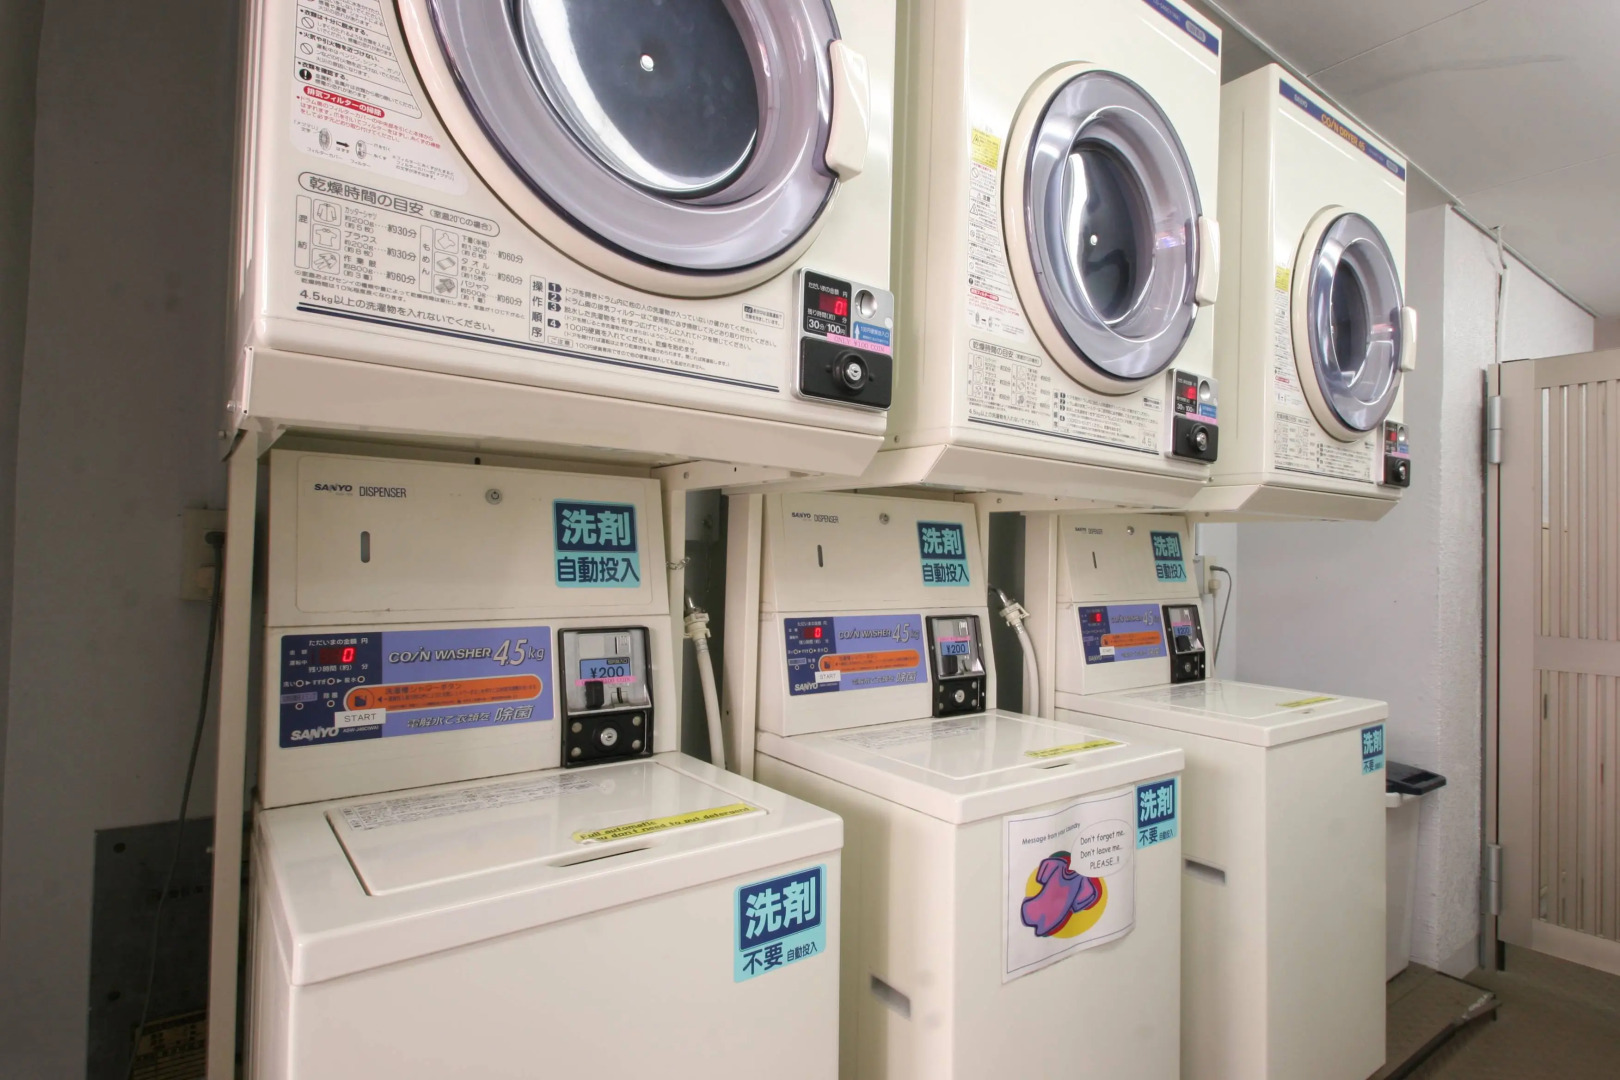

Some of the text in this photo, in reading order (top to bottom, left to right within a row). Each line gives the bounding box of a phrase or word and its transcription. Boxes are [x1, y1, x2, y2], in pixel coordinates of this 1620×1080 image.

[308, 176, 424, 218] 乾燥時間の目安
[314, 483, 407, 498] SANYO DISPENSER
[791, 511, 839, 523] SANYO DISPENSER
[560, 508, 631, 547] 洗剤
[921, 527, 963, 555] 洗剤
[1153, 536, 1181, 557] 洗剤
[556, 556, 640, 583] 自動投入
[922, 562, 970, 583] 自動投入
[1156, 563, 1187, 580] 自動投入
[814, 626, 822, 638] 0
[861, 629, 892, 639] WASHER
[308, 637, 368, 647] ただいまの金額 円
[946, 643, 966, 654] ¥200
[342, 647, 355, 663] 0
[434, 648, 492, 660] WASHER
[590, 666, 625, 679] ¥200
[794, 682, 819, 692] SANYO
[344, 712, 377, 723] START
[493, 705, 535, 722] 除菌
[290, 727, 340, 741] SANYO
[1362, 728, 1383, 756] 洗剤
[1362, 759, 1375, 774] 不要
[1140, 784, 1173, 822] 洗剤
[580, 820, 657, 840] Full automatic
[642, 823, 667, 834] need
[1139, 826, 1158, 846] 不要
[1022, 834, 1049, 846] Message
[1080, 835, 1095, 846] Don't
[1096, 831, 1115, 843] forget
[1080, 848, 1095, 860] Don't
[1096, 846, 1111, 857] leave
[745, 875, 817, 939] 洗剤
[742, 941, 819, 976] 不要 自動投入
